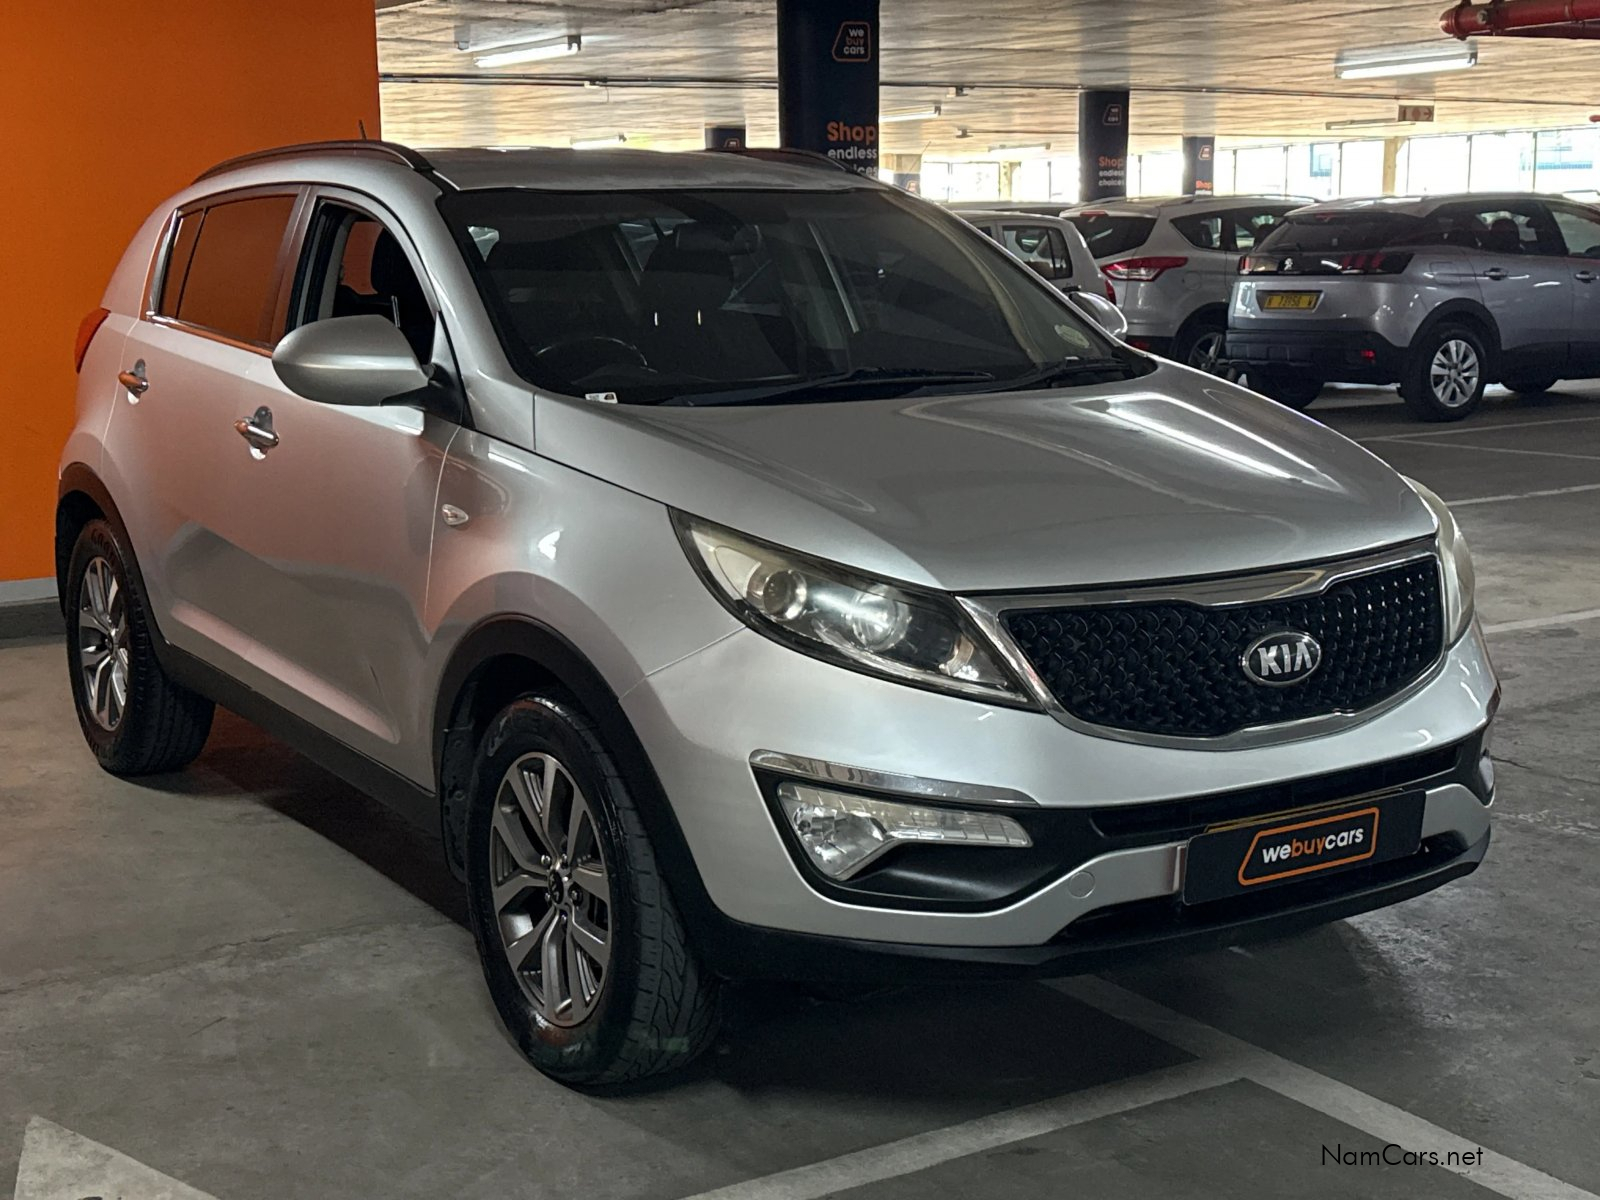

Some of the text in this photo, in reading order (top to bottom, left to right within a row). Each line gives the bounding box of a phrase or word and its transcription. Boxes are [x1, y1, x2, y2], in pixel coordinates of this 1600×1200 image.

[848, 28, 864, 37] we
[843, 46, 865, 55] cars
[827, 121, 876, 144] Shop
[828, 146, 877, 159] endless
[1099, 156, 1124, 168] Shop
[1257, 642, 1312, 676] KIA
[1262, 827, 1364, 863] webuycars
